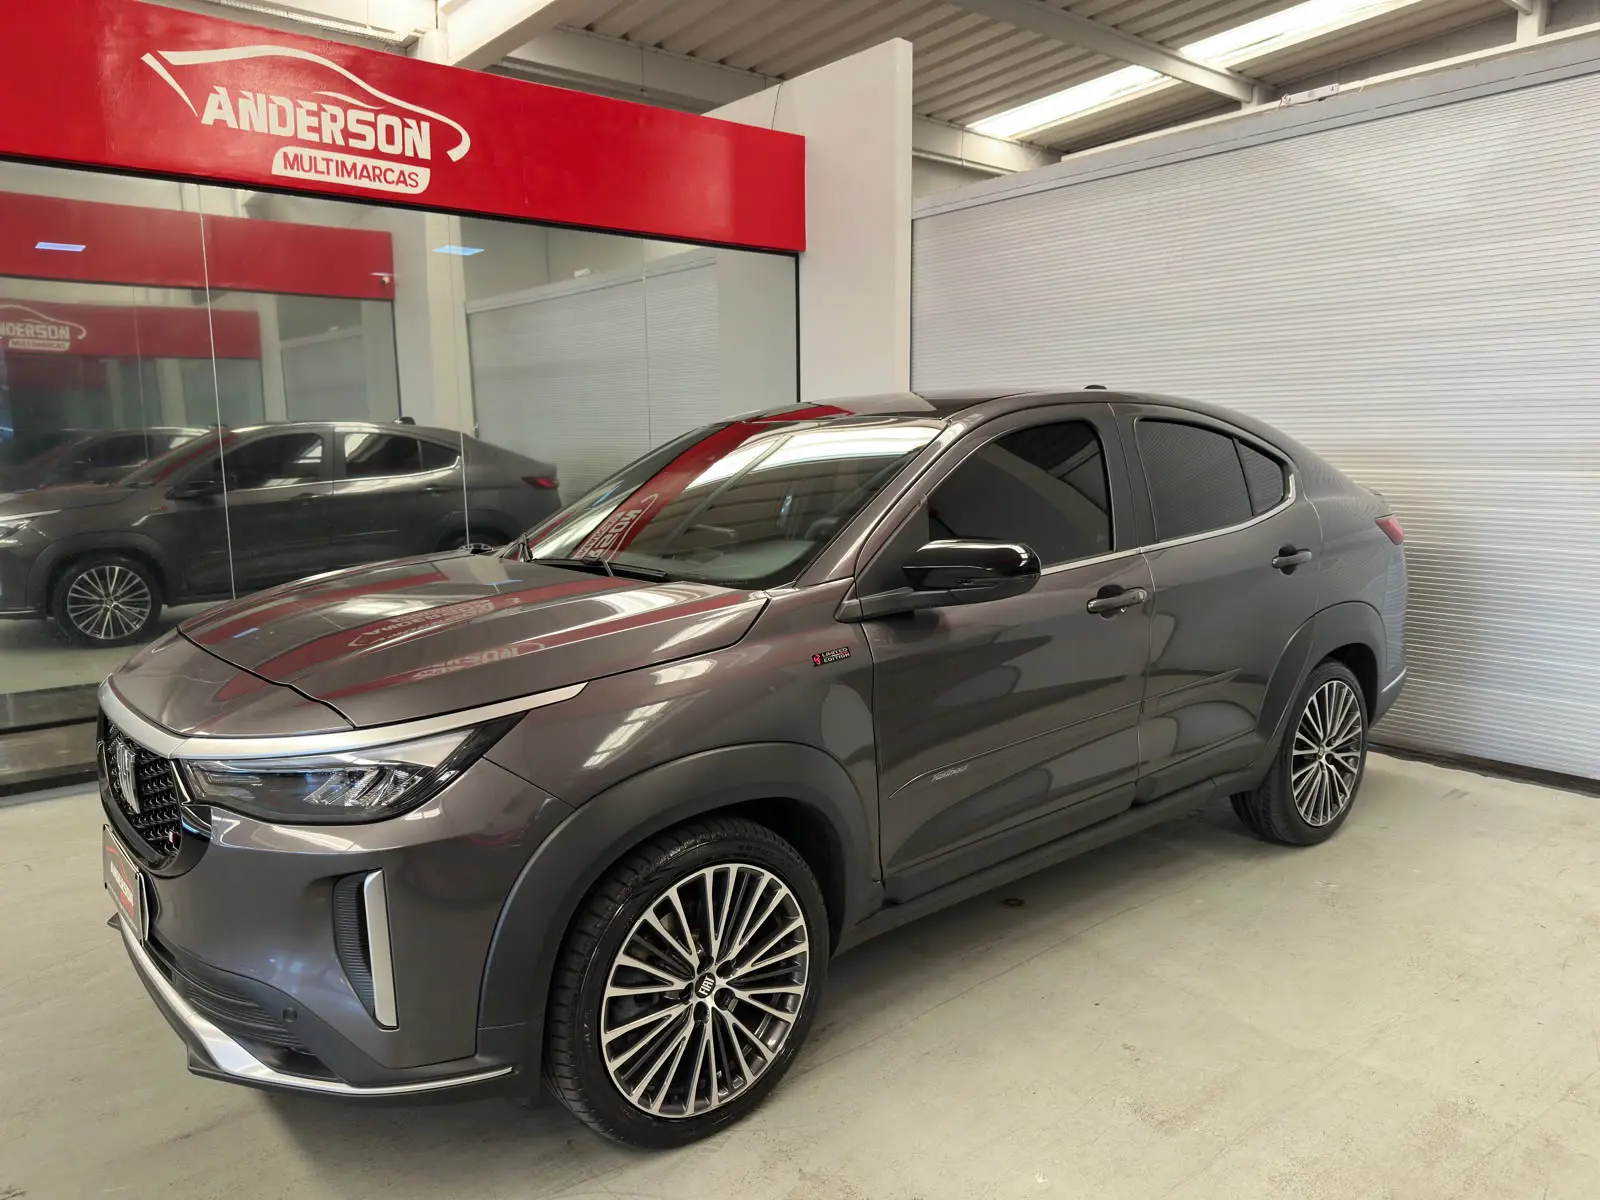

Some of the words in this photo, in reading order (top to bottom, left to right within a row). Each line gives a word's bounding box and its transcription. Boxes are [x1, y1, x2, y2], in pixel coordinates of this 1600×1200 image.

[201, 85, 432, 160] ANDERSON
[283, 152, 420, 189] MULTIMARCAS
[821, 647, 848, 658] LIMITED
[823, 652, 850, 663] EDITION
[698, 975, 715, 996] FIAT
